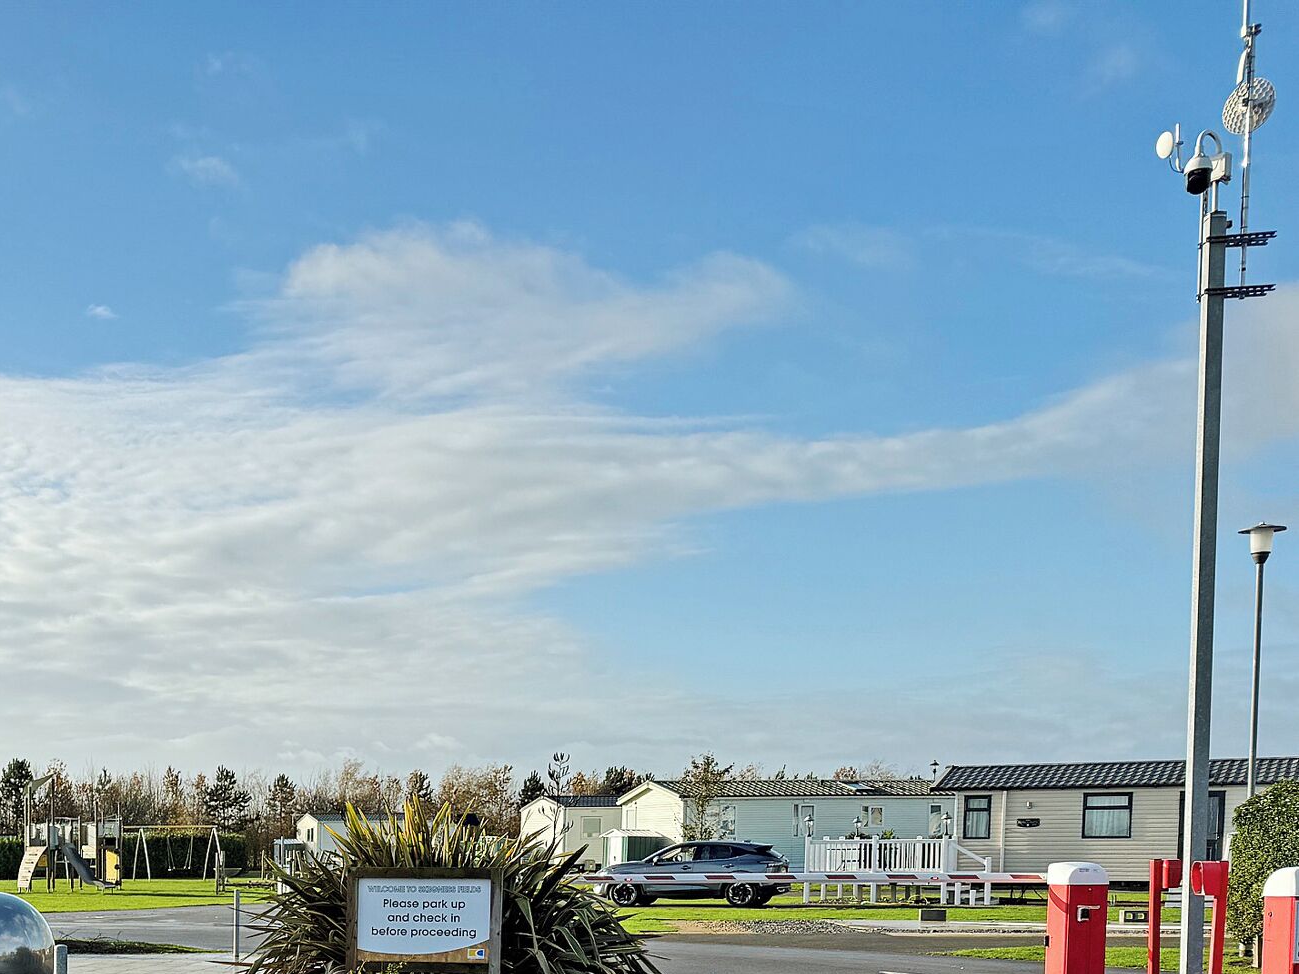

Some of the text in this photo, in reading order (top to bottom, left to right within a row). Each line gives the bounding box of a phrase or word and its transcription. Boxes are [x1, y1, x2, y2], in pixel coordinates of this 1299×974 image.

[367, 885, 405, 893] WELCOME
[406, 885, 417, 893] TO
[457, 885, 482, 893] FIELDS
[383, 899, 466, 910] Please park up
[387, 913, 461, 922] and check in
[371, 926, 477, 939] before proceeding
